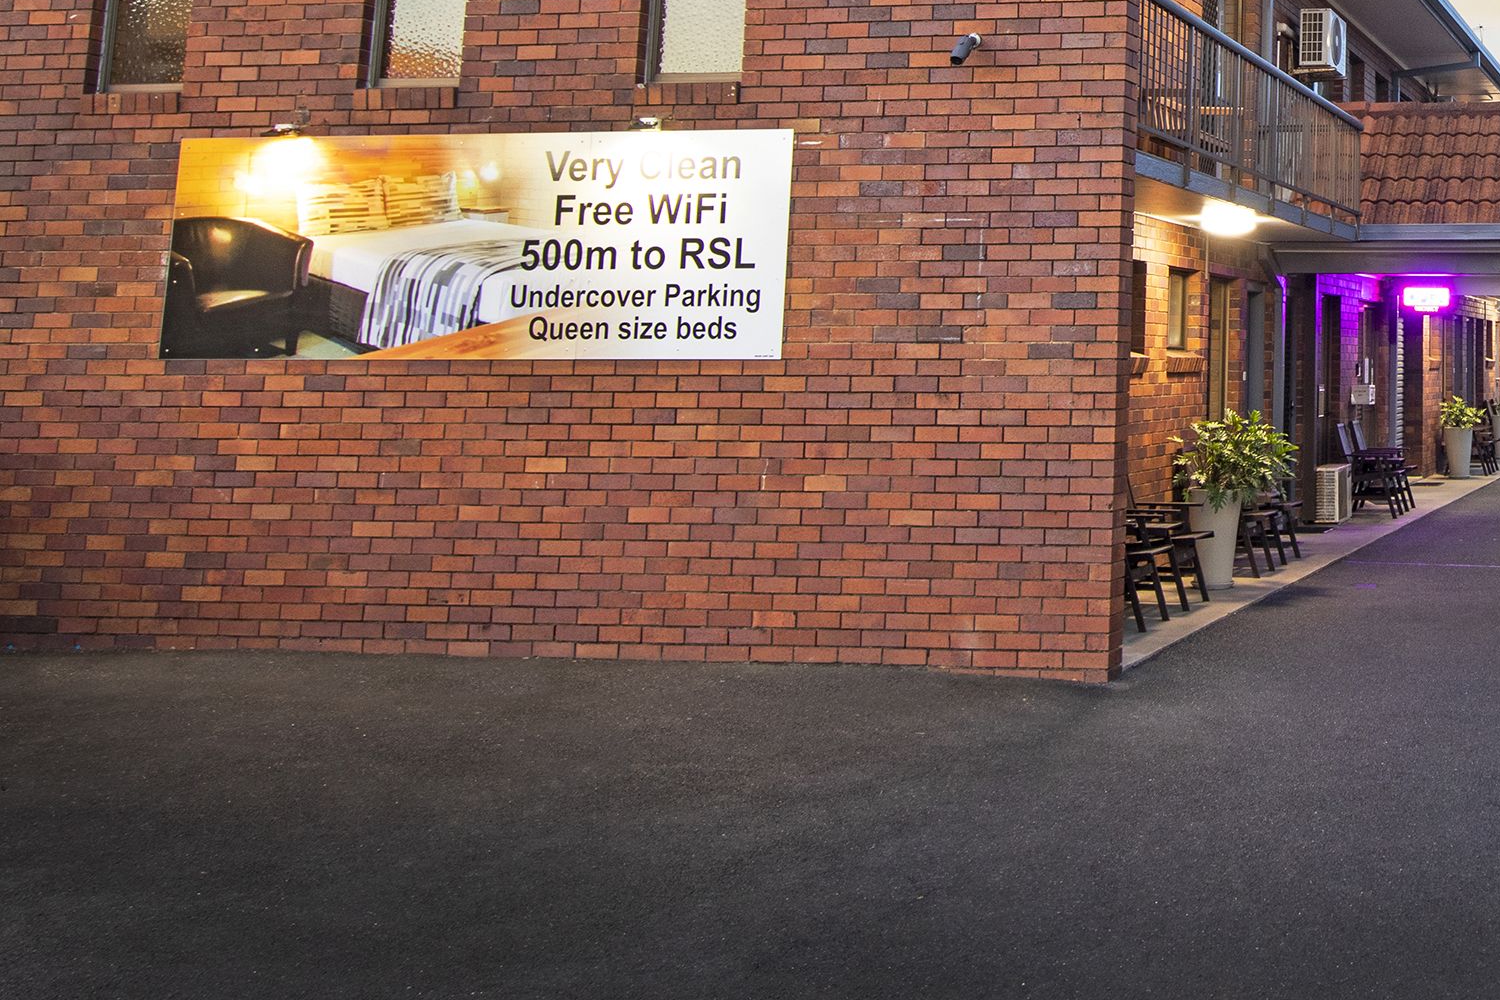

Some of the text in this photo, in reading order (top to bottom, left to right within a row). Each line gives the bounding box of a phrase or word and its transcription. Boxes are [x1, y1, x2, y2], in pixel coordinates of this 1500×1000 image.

[545, 150, 742, 189] Very Clean
[554, 192, 728, 226] Free WiFi
[520, 237, 756, 271] 500m to RSL
[510, 283, 761, 313] Undercover Parking
[528, 316, 738, 341] Queen size beds
